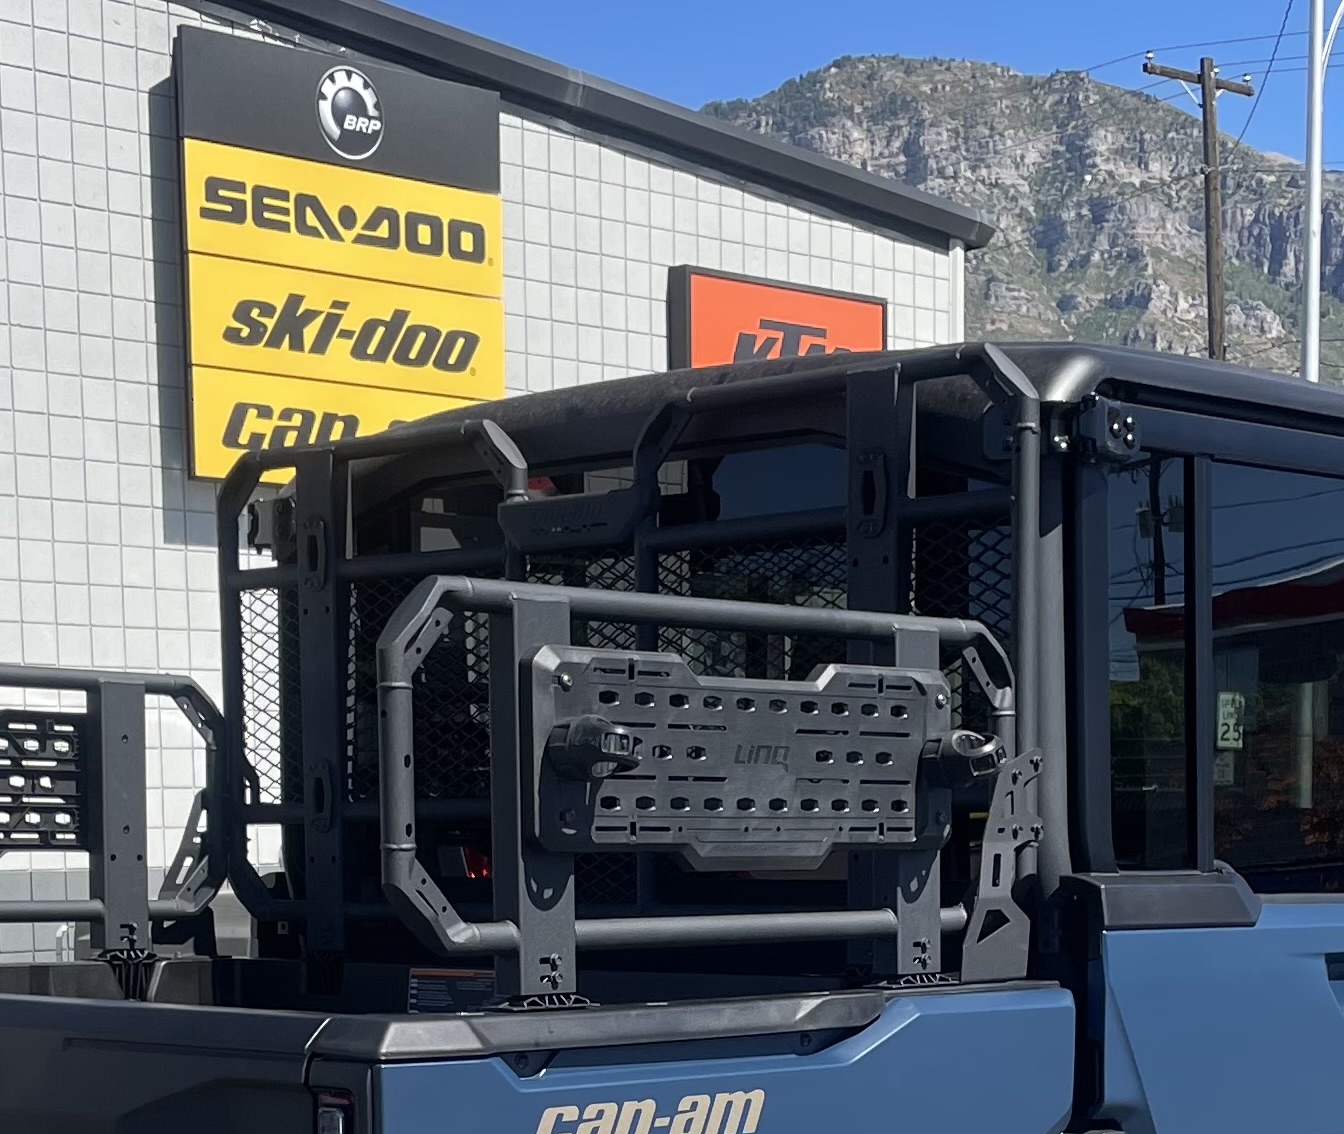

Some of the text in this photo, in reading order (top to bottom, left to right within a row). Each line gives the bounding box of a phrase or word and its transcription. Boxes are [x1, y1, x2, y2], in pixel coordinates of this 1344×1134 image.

[343, 114, 381, 135] BRP
[222, 293, 481, 374] ski-doo
[1220, 722, 1241, 742] 25
